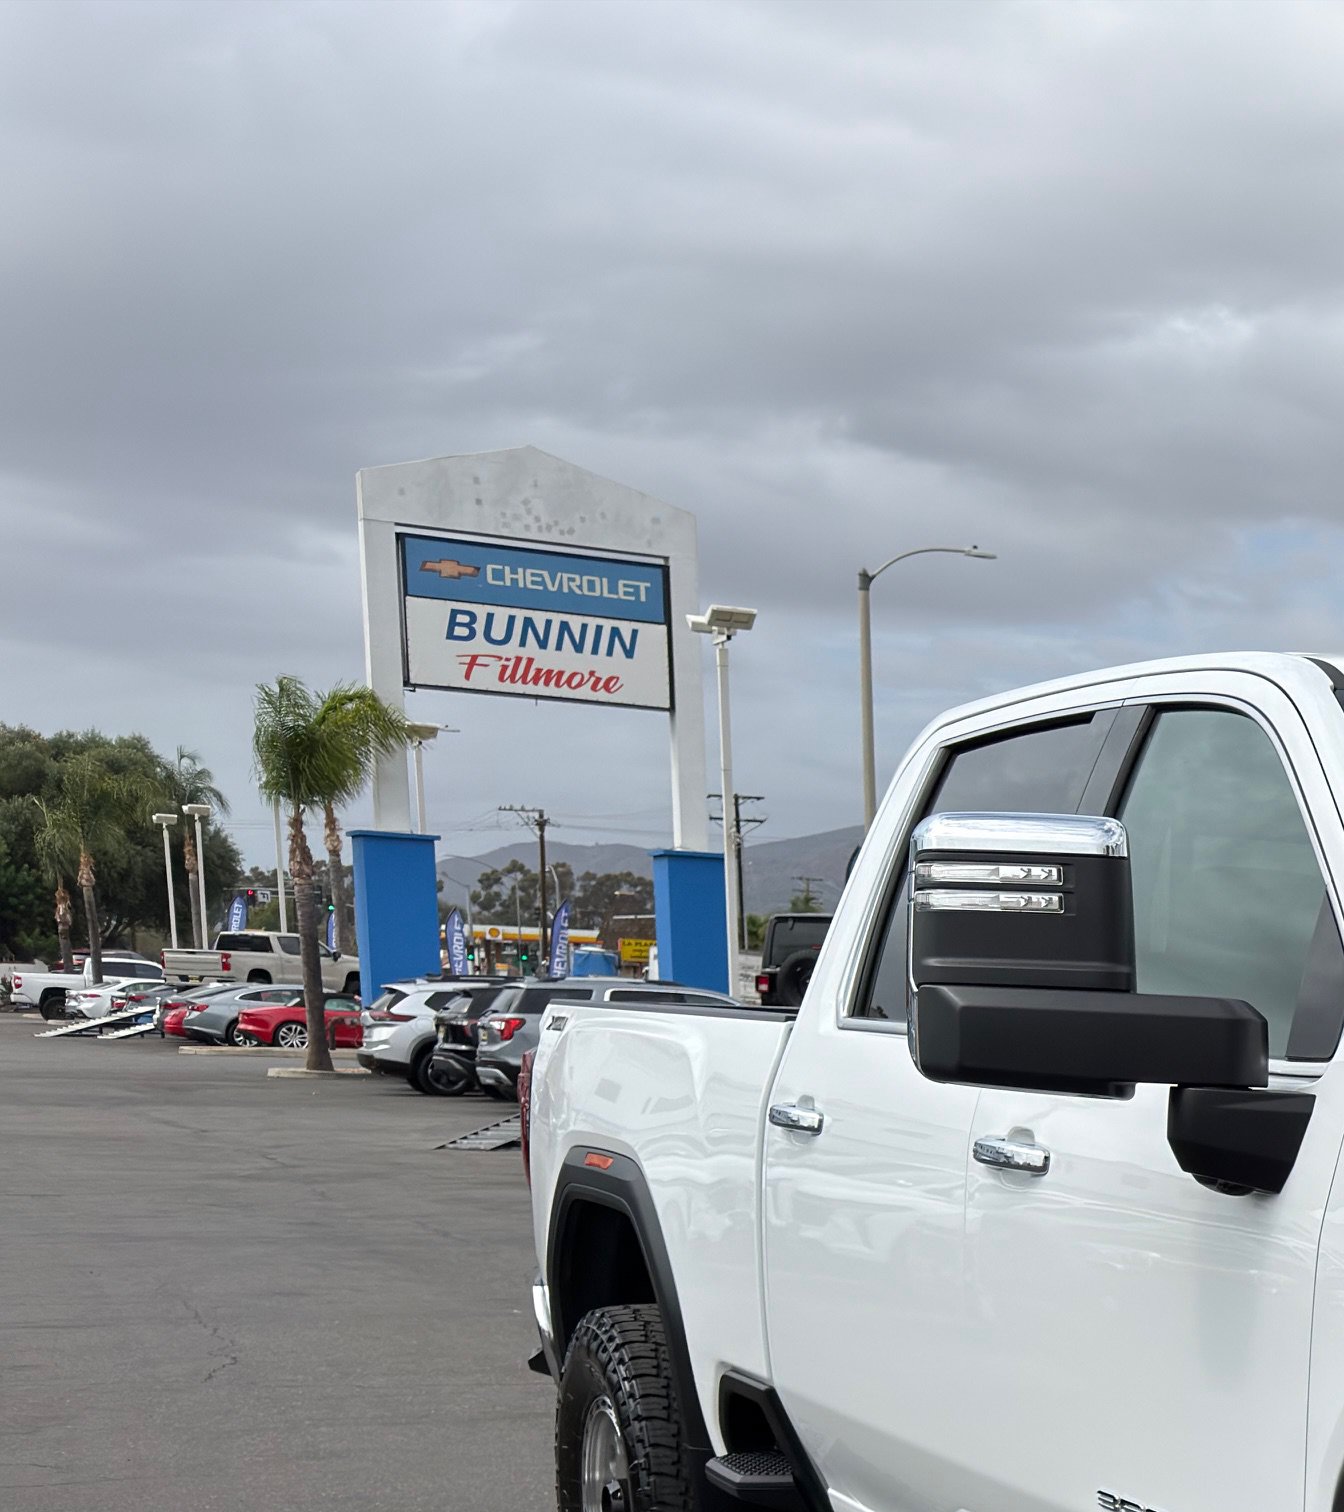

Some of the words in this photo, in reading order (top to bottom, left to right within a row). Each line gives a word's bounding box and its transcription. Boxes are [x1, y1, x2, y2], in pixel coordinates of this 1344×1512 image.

[486, 564, 651, 602] CHEVROLET
[445, 608, 639, 659] BUNNIN
[455, 653, 625, 694] Fillmore
